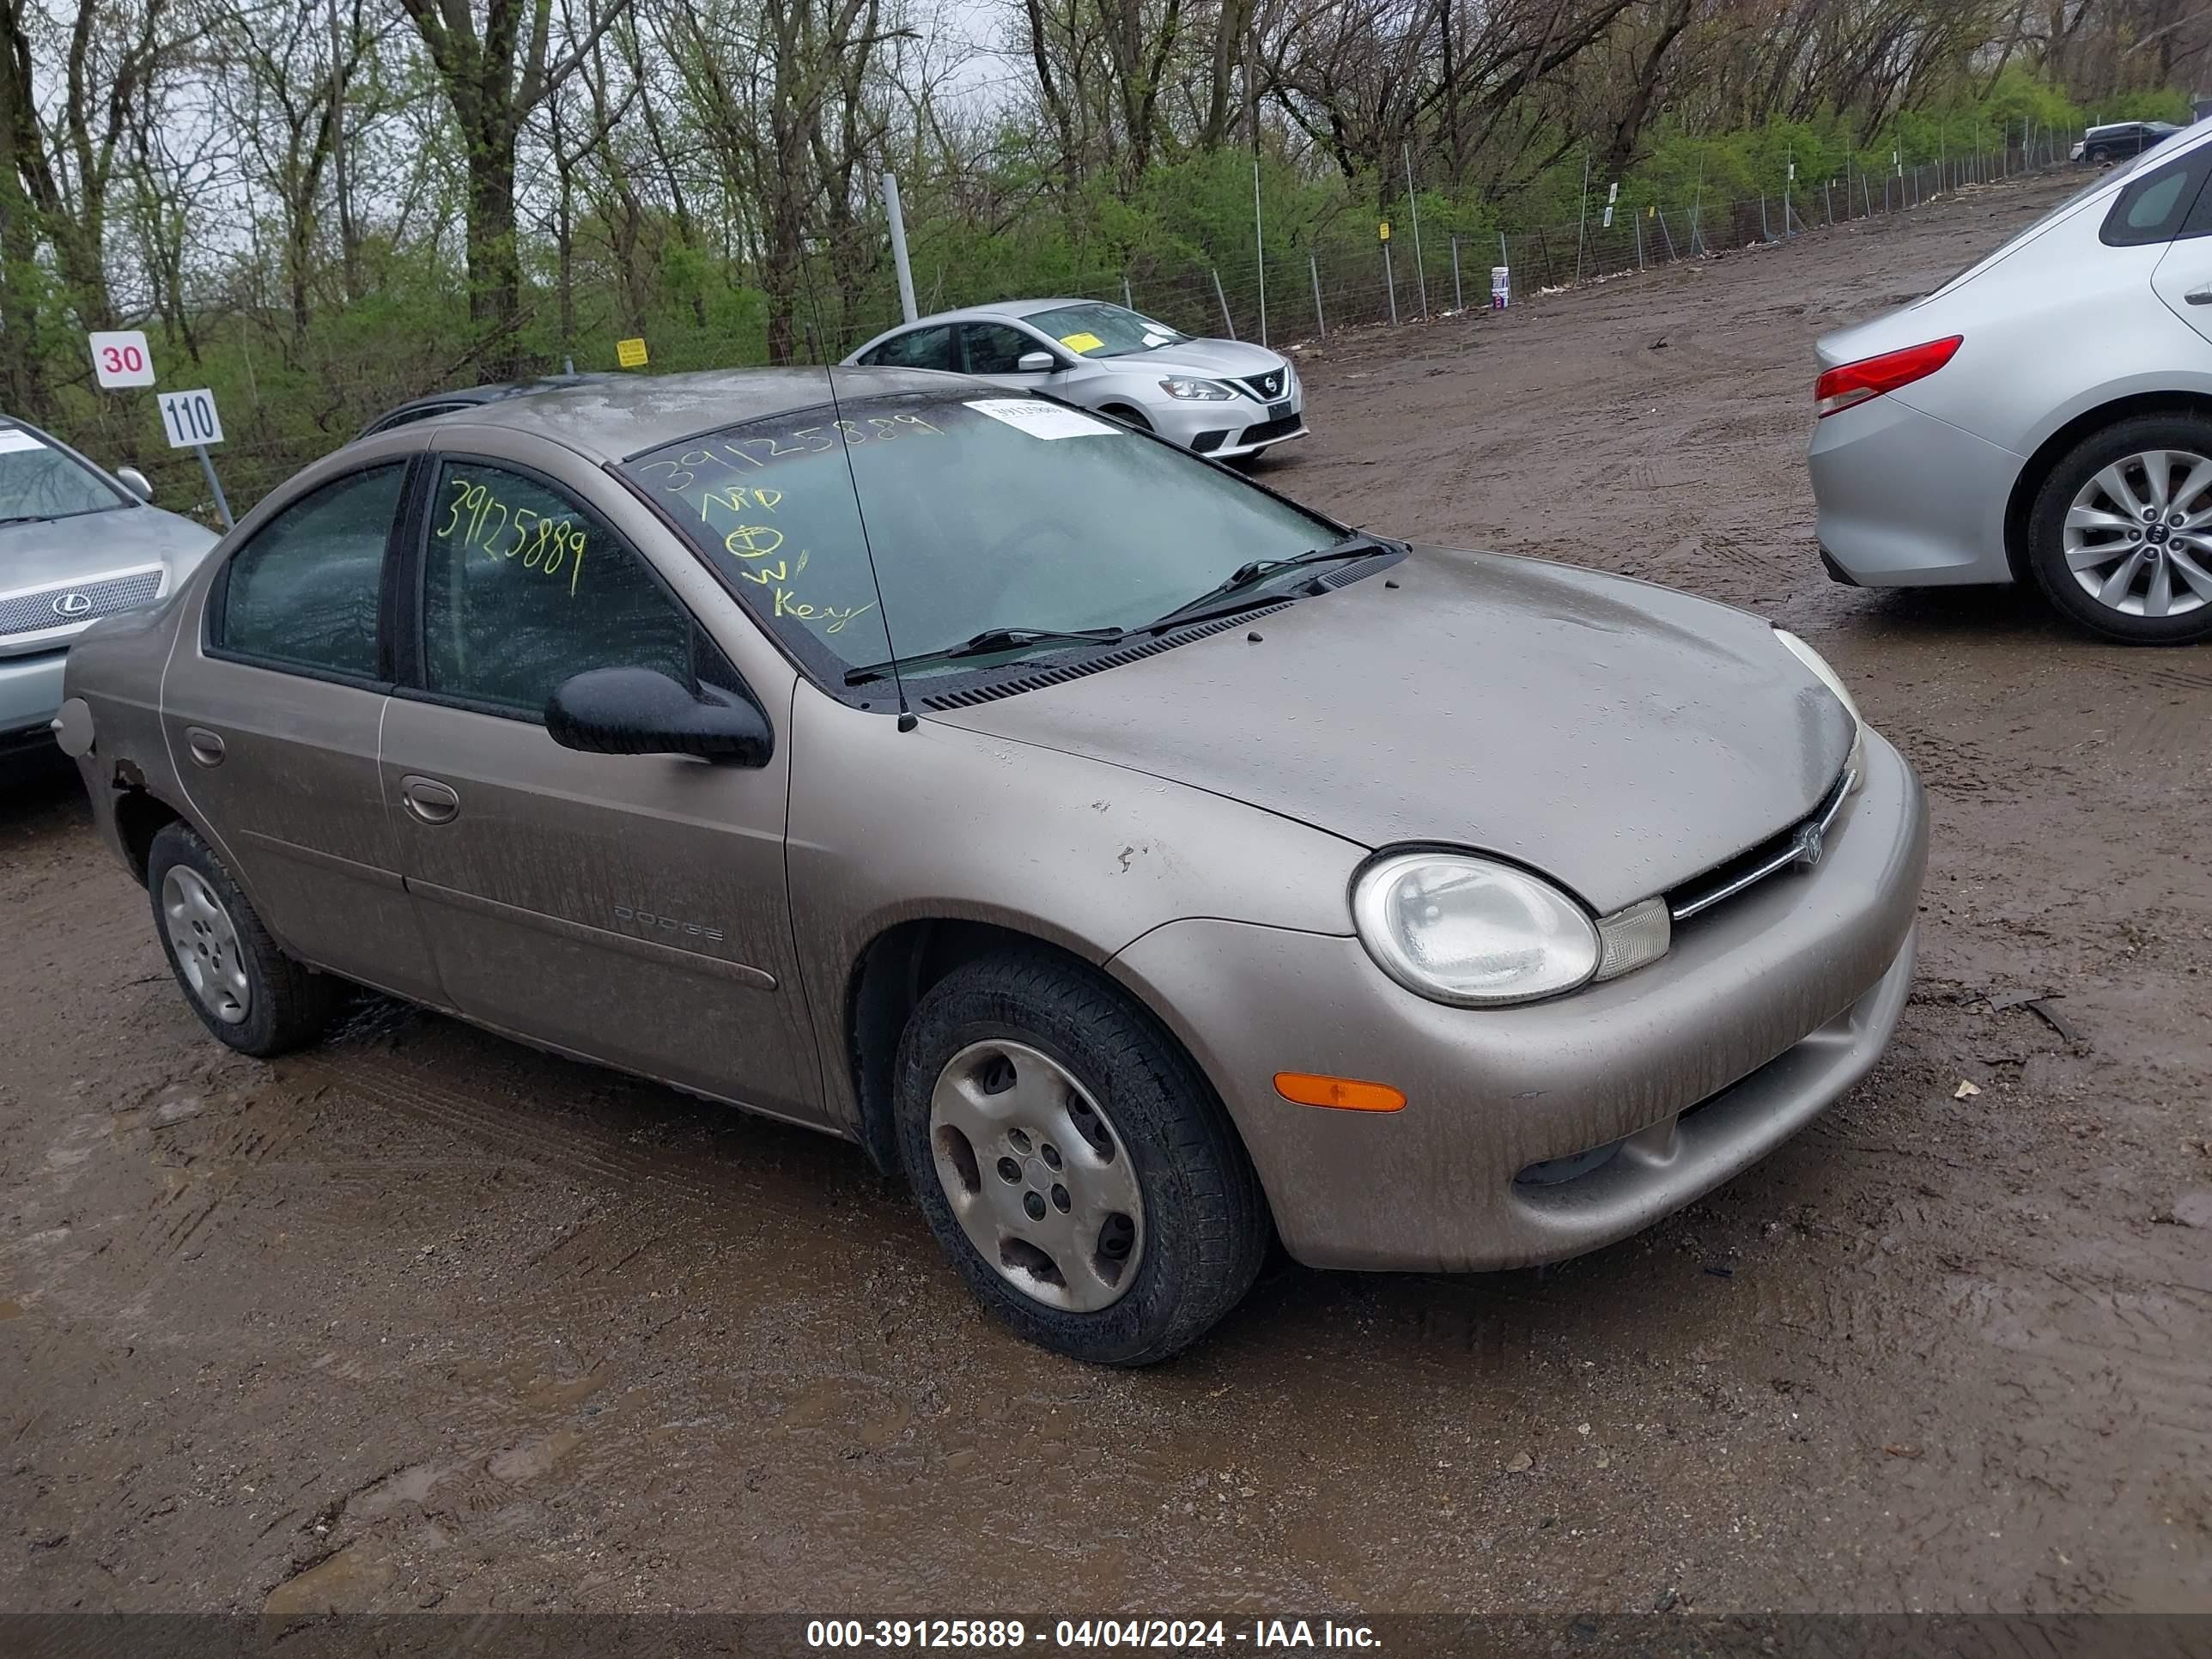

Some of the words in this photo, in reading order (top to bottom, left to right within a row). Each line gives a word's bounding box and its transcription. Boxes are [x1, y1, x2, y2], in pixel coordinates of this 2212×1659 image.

[102, 346, 143, 374] 30
[167, 395, 214, 441] 110
[639, 414, 945, 492] 39125889
[437, 479, 586, 598] 39125889
[775, 587, 879, 634] Key
[614, 905, 725, 942] DODGE
